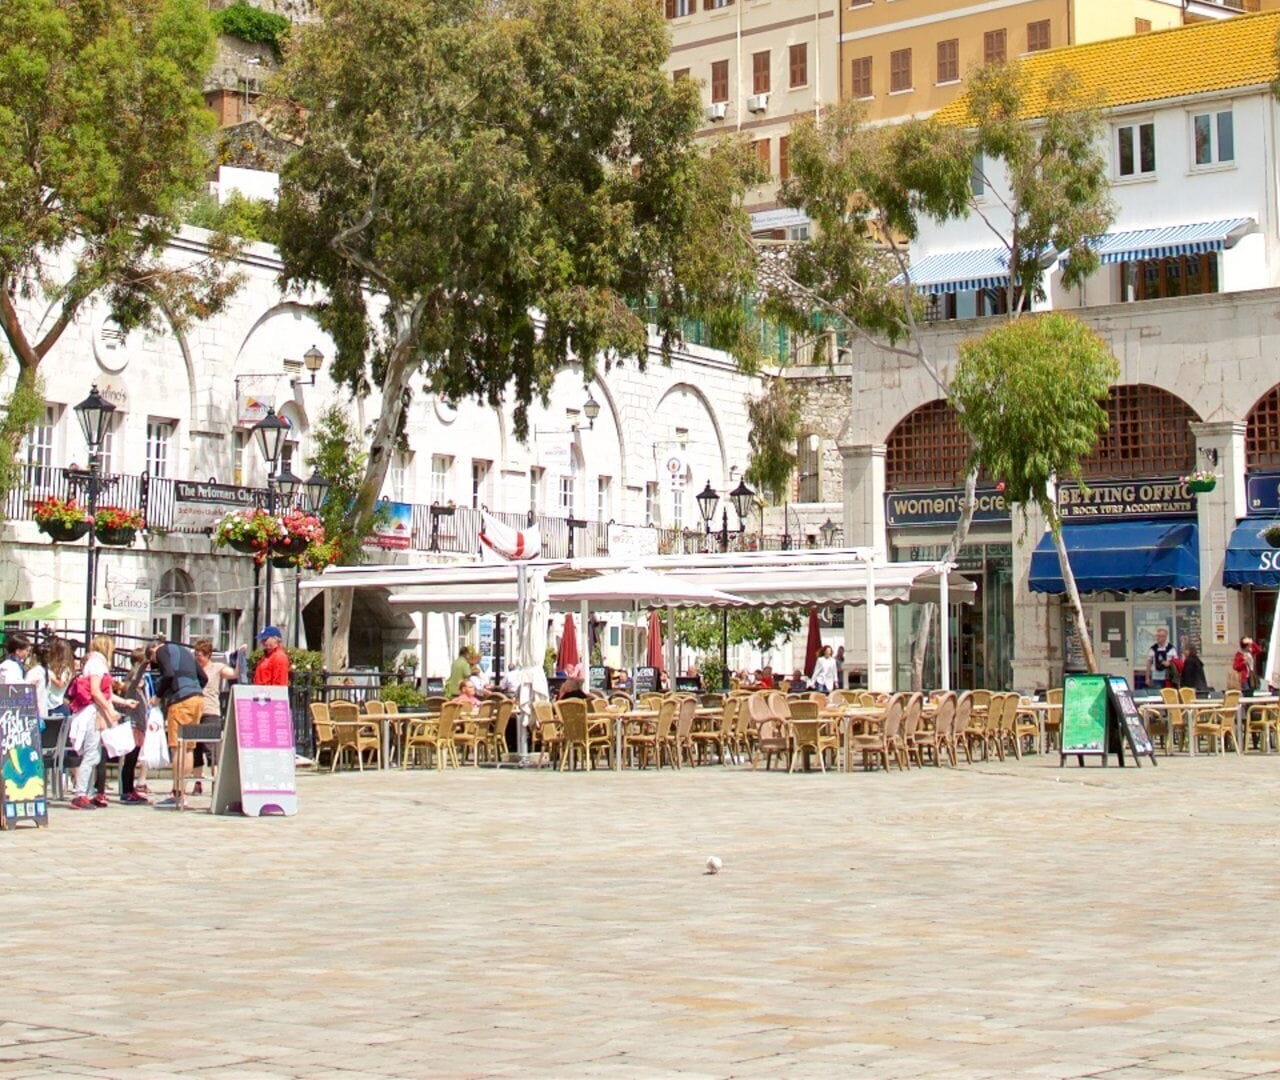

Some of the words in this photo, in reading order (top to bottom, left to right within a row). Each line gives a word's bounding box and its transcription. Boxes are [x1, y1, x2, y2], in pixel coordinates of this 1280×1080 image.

[178, 483, 196, 497] The
[1061, 485, 1136, 505] BETTING
[1140, 483, 1197, 501] OFFIC
[1072, 505, 1098, 516] ROCK
[1124, 501, 1191, 513] ACCOUNTANTS
[112, 595, 149, 609] Latino's
